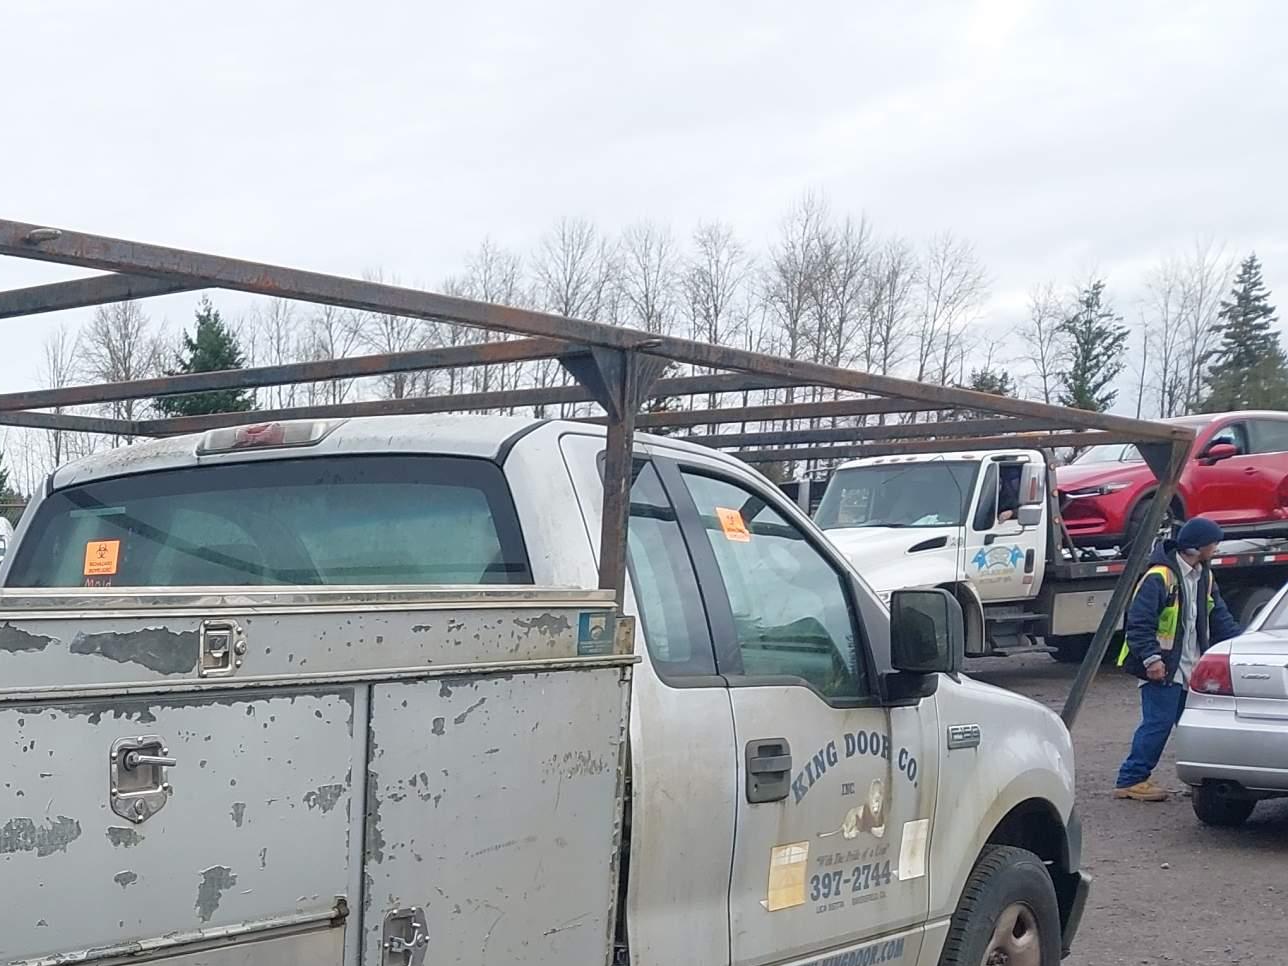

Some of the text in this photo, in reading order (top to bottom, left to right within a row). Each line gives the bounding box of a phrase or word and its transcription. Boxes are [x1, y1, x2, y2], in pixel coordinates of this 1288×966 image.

[792, 730, 918, 805] KING DOOR CO.
[810, 859, 891, 902] 397-2744
